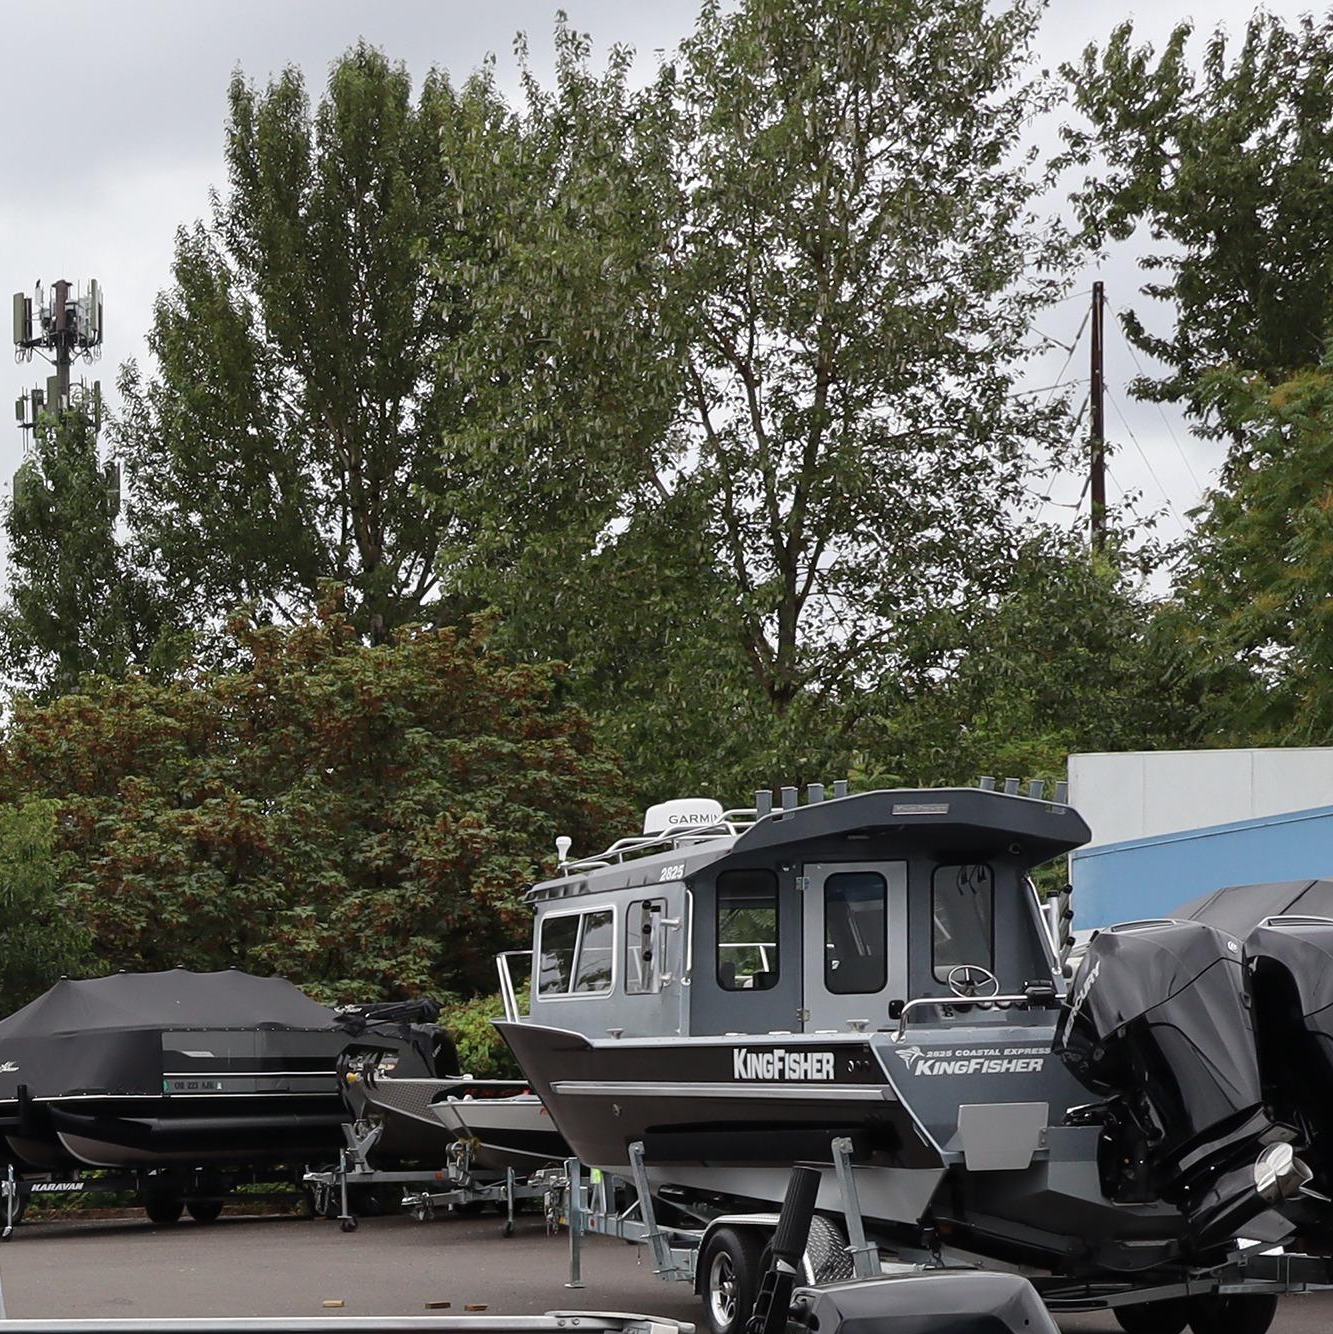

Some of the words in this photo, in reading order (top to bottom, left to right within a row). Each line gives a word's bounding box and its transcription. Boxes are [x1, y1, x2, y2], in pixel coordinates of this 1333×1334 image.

[659, 864, 685, 882] 2825
[955, 1048, 1001, 1056] COASTAL
[1003, 1048, 1051, 1056] EXPRESS
[31, 1182, 84, 1192] KARAVAN
